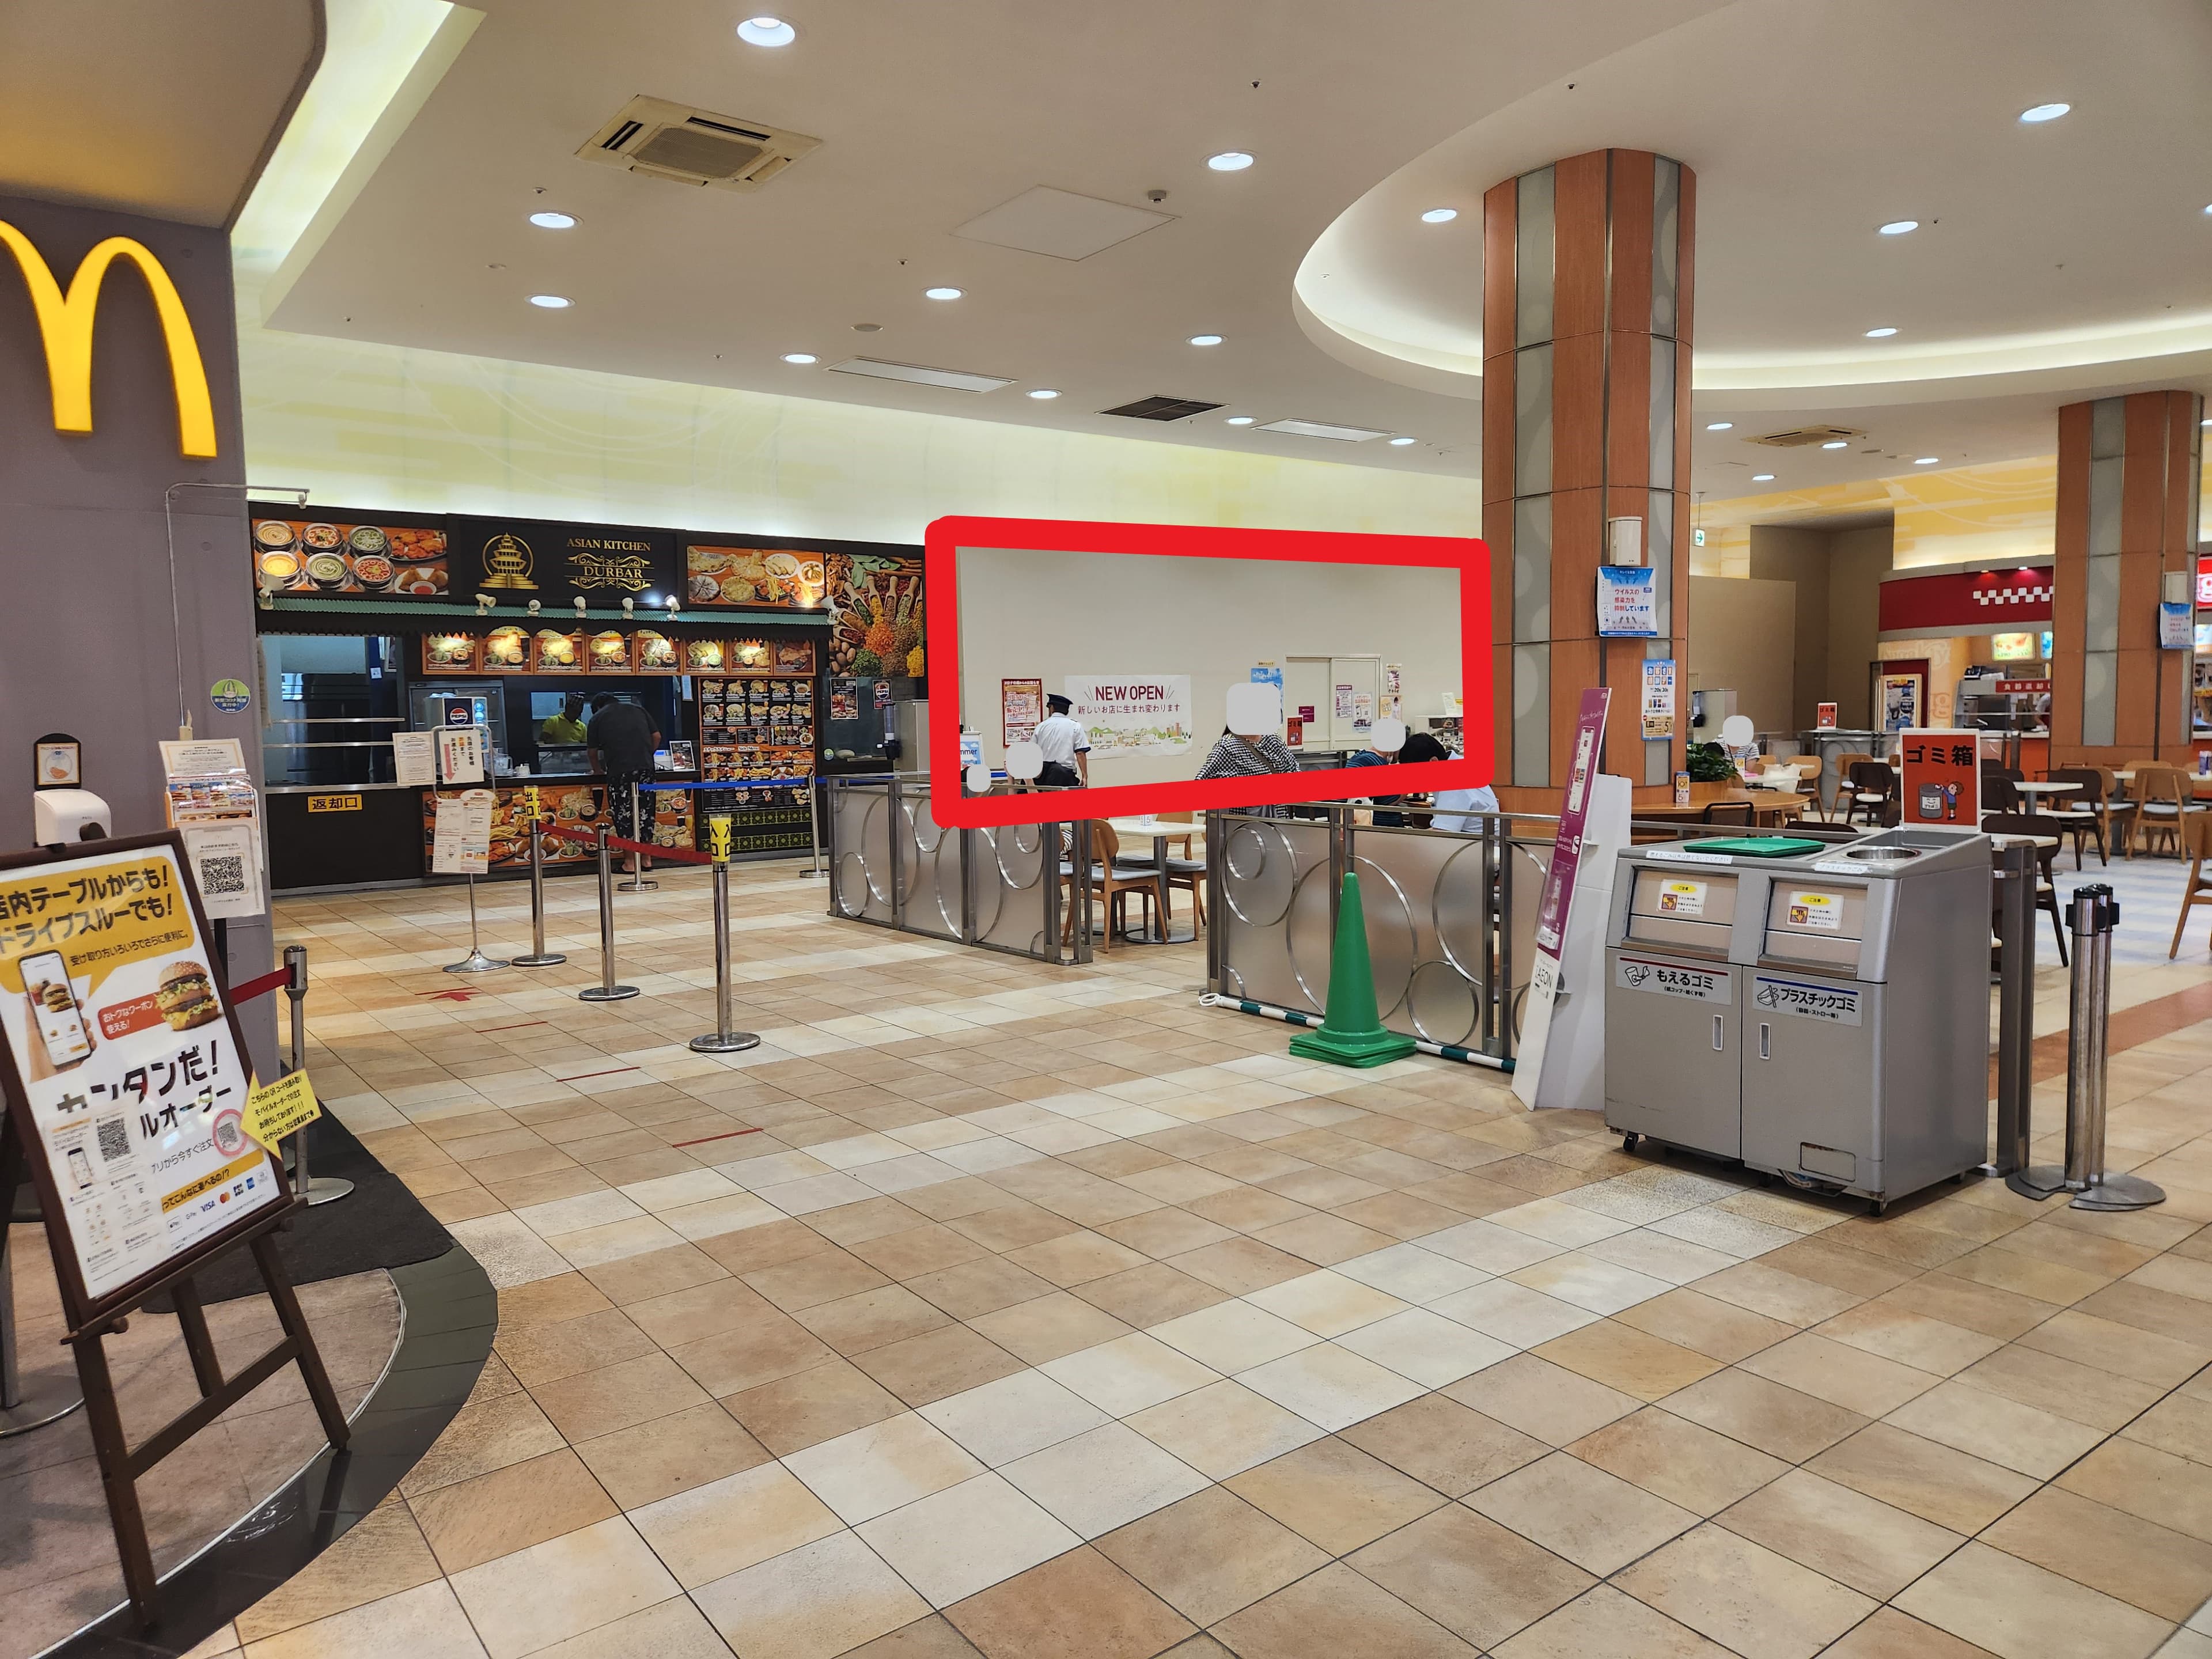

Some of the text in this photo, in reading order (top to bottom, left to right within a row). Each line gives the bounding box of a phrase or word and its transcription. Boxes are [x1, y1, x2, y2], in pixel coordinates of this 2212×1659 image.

[567, 538, 652, 551] ASIAN KITCHEN
[584, 566, 643, 578] DURBAR
[1096, 685, 1164, 700] NEW OPEN
[1078, 703, 1180, 715] 新しいお店に生まれ変わります
[1907, 745, 1973, 766] ゴミ箱
[312, 797, 357, 810] 返却口
[69, 930, 189, 967] 受け取り方いろいろでさらに便利に。
[1657, 969, 1714, 990] もえるゴミ
[1664, 986, 1706, 998] (紙コップ・紙くず等)
[1781, 988, 1856, 1013] プラスチックゴミ
[103, 1000, 153, 1023] おトクなクーポン
[106, 1019, 130, 1034] 使える!
[200, 1200, 216, 1213] VISA
